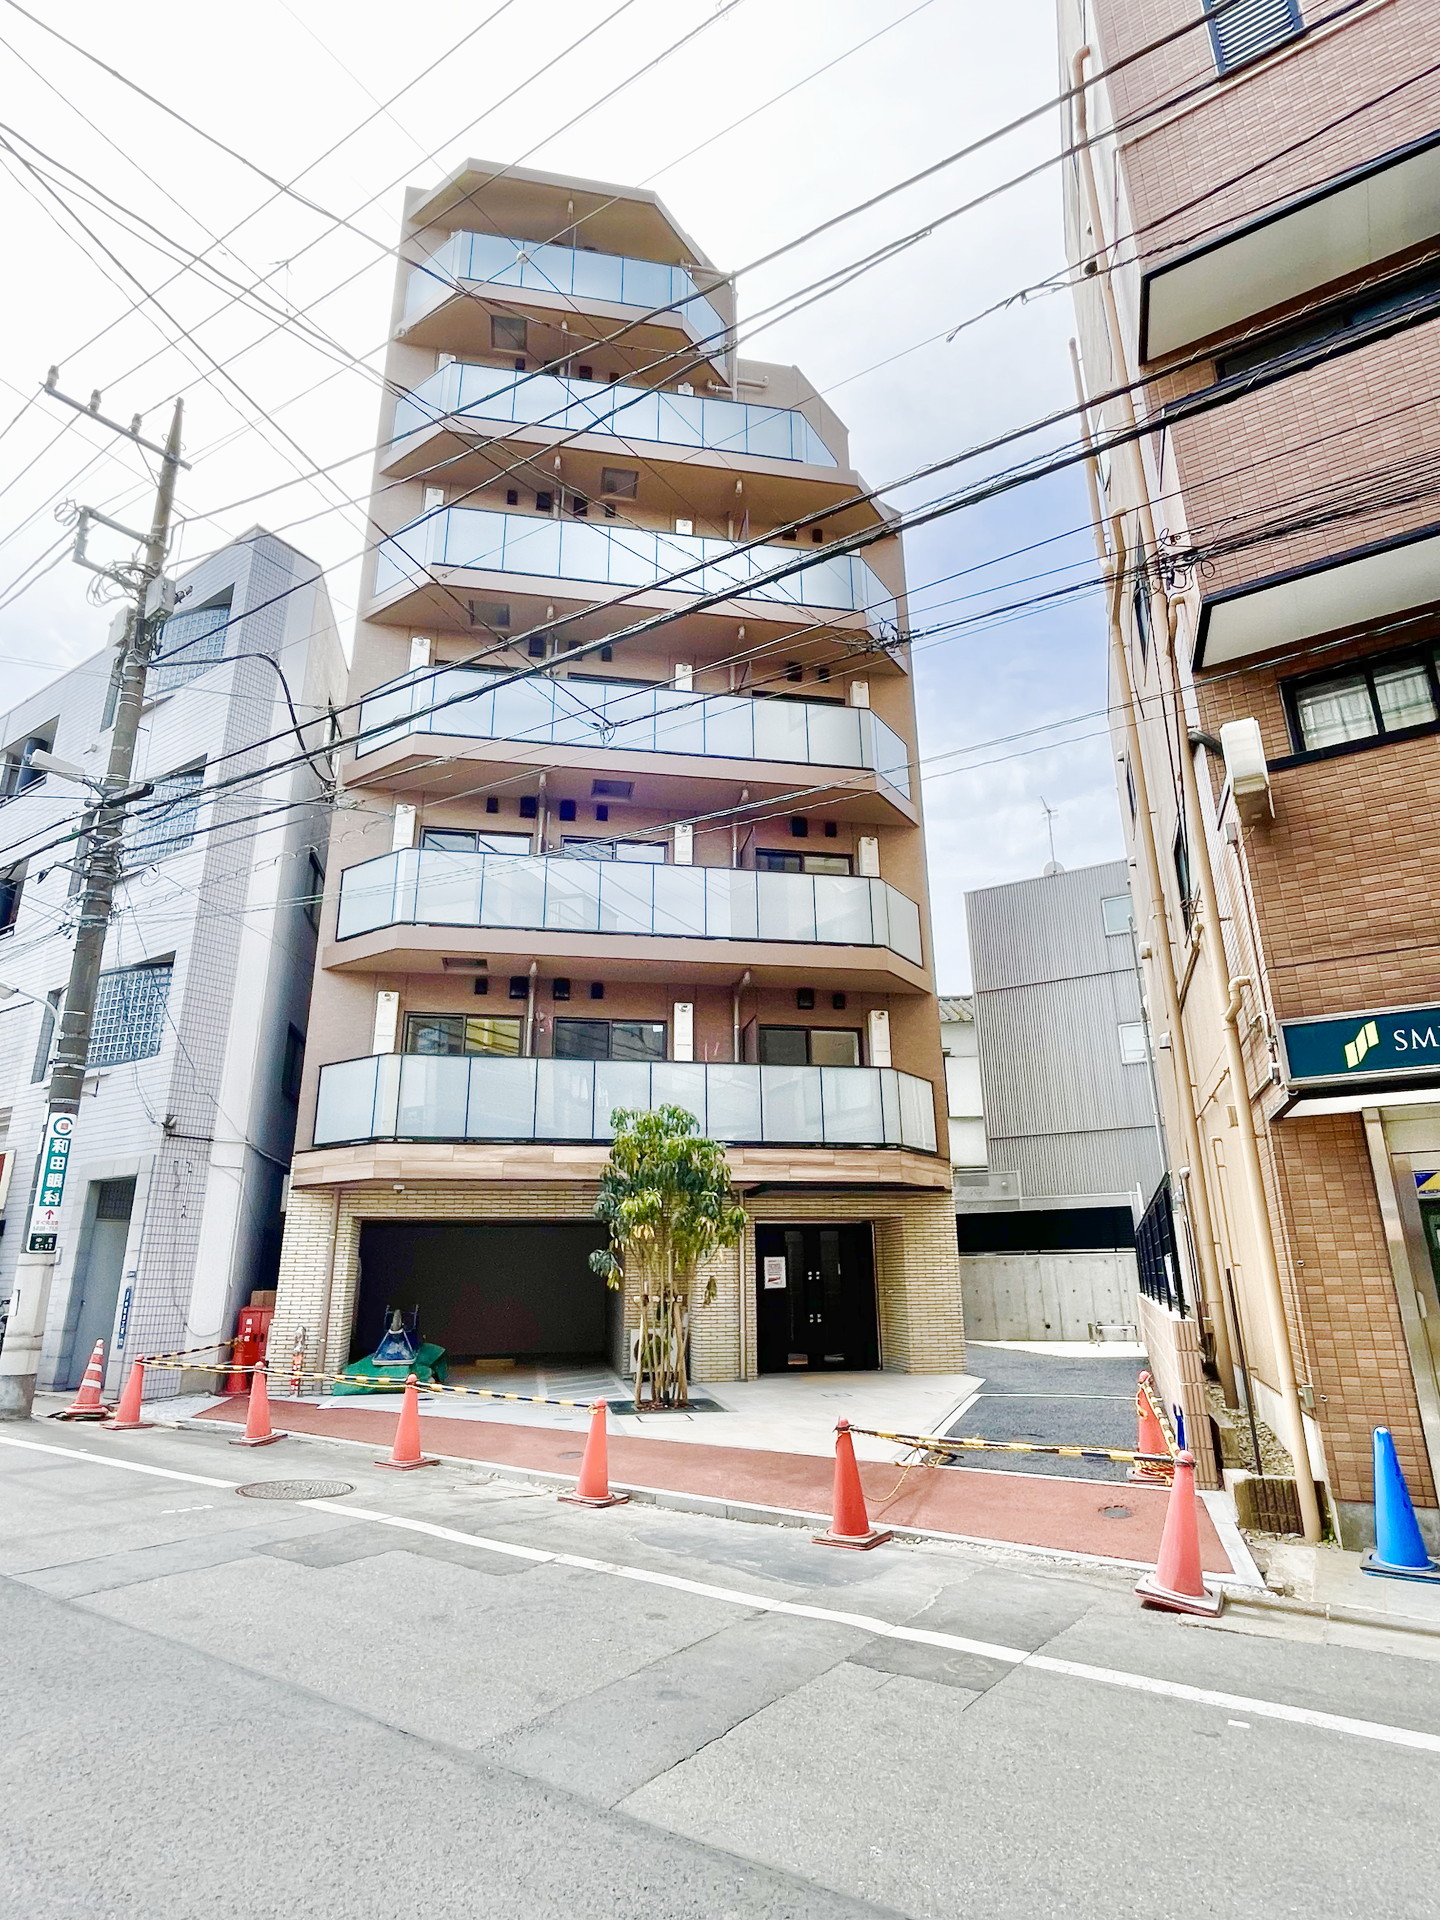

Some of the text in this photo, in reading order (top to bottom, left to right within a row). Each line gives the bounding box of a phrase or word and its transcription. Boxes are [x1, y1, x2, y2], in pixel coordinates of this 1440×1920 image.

[1393, 1026, 1440, 1051] SM
[42, 1138, 69, 1206] 和田眼科
